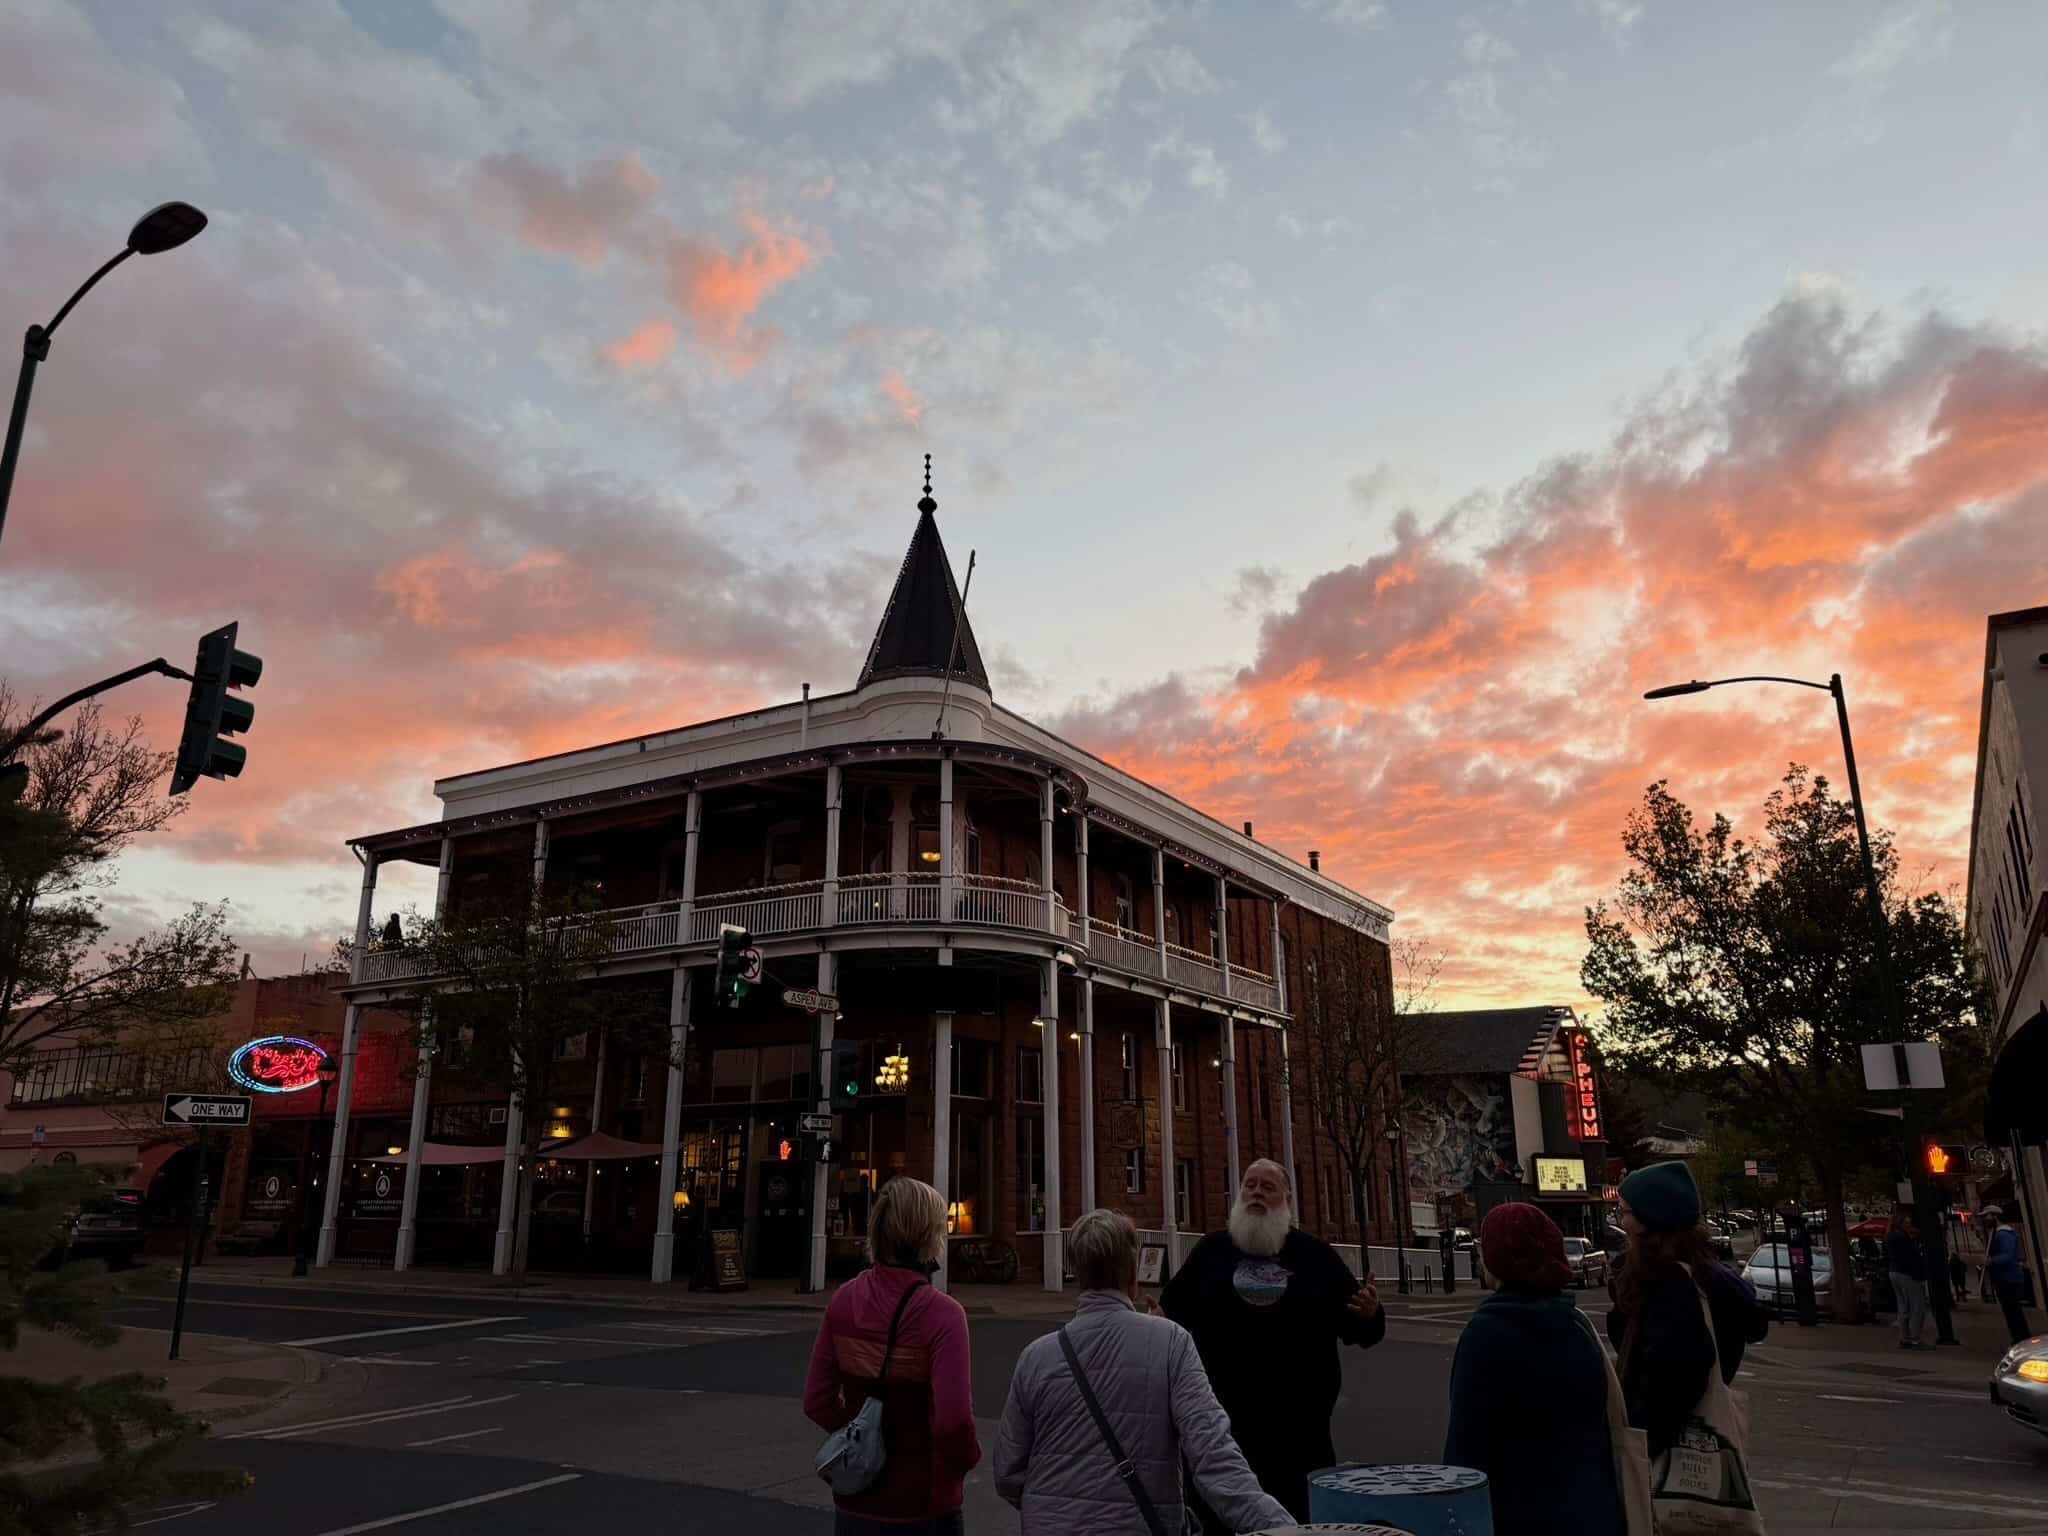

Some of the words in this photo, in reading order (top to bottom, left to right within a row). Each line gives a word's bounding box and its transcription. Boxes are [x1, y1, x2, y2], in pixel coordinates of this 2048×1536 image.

[790, 993, 817, 1005] ASPEN
[818, 998, 833, 1009] AVE
[191, 1103, 215, 1115] ONE
[218, 1104, 241, 1116] WAY
